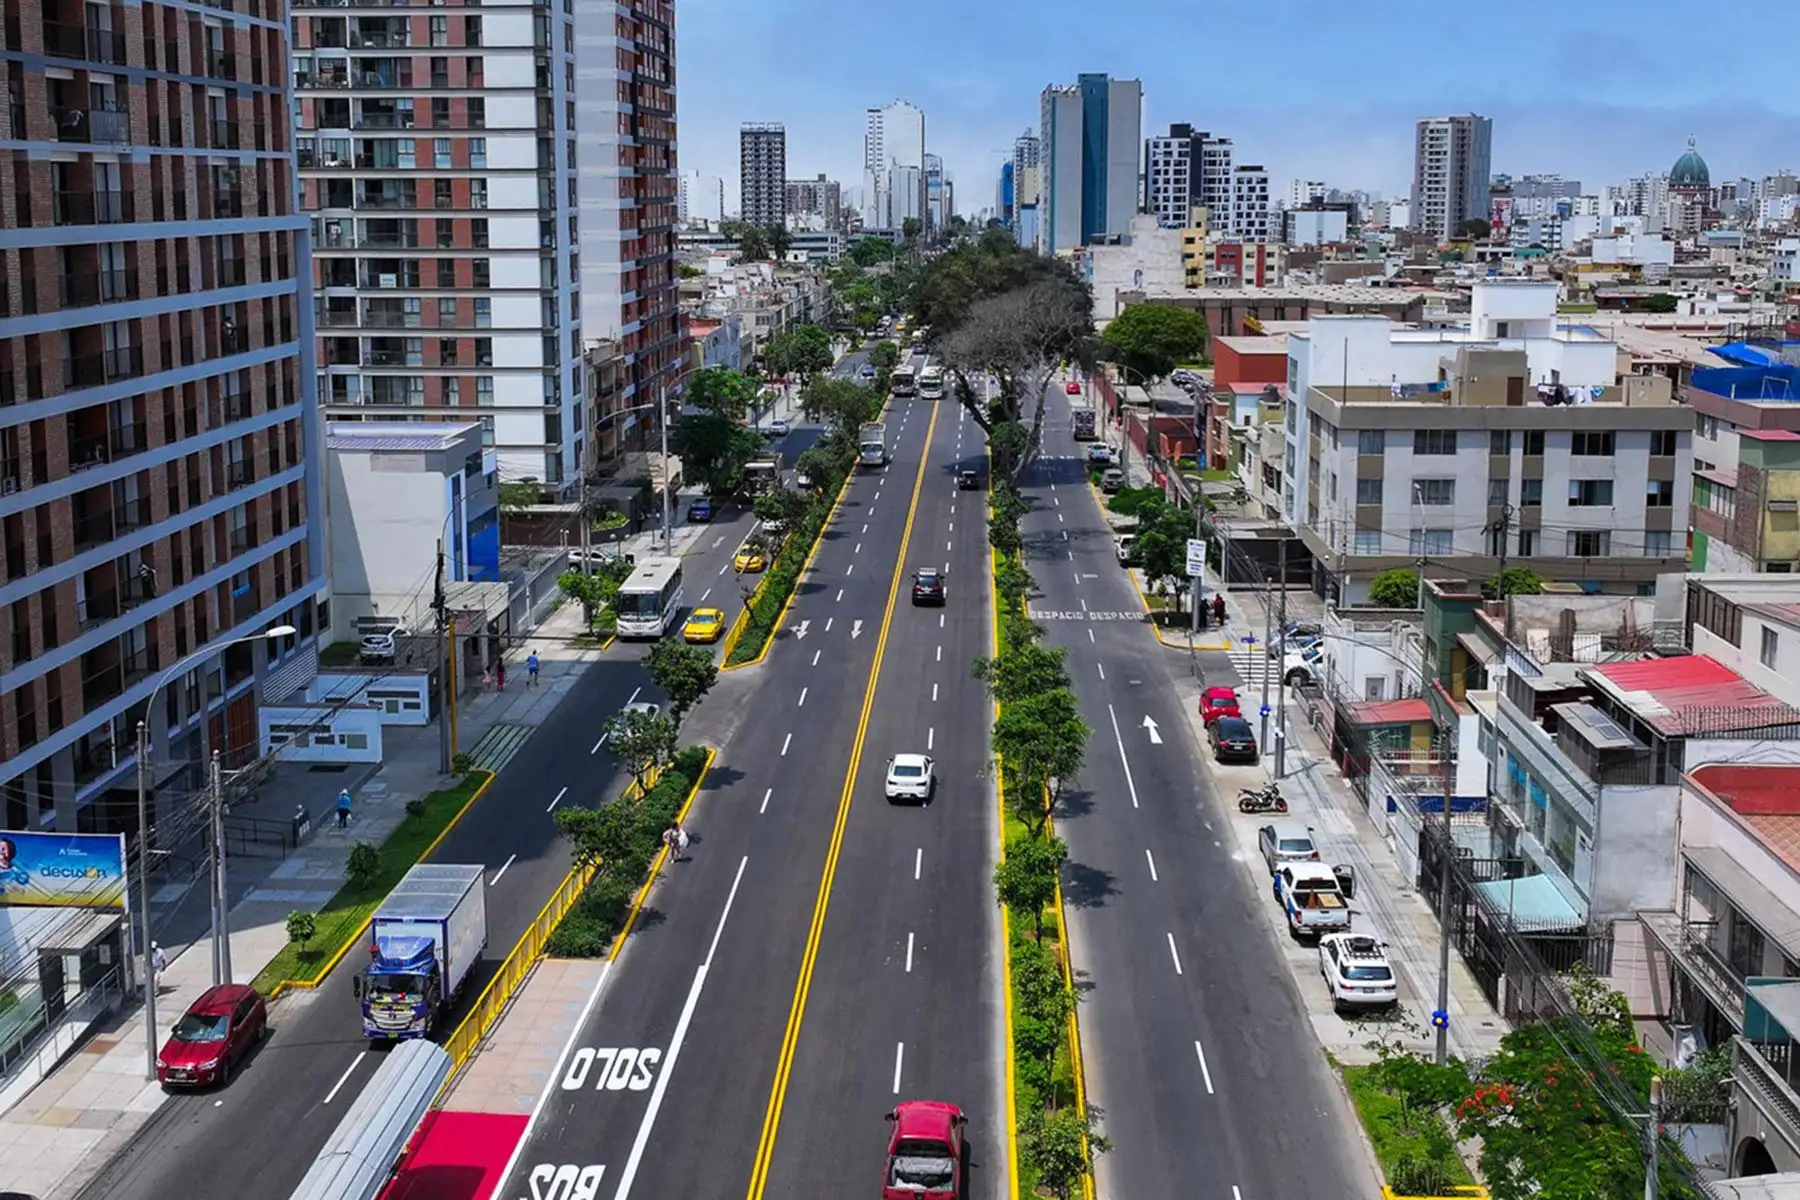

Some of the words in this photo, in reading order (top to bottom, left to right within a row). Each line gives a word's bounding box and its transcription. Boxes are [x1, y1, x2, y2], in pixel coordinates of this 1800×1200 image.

[1030, 610, 1084, 620] DESPACIO
[1089, 611, 1145, 620] DESPACIO
[561, 1047, 662, 1091] SOLO
[519, 1164, 607, 1200] BUS
